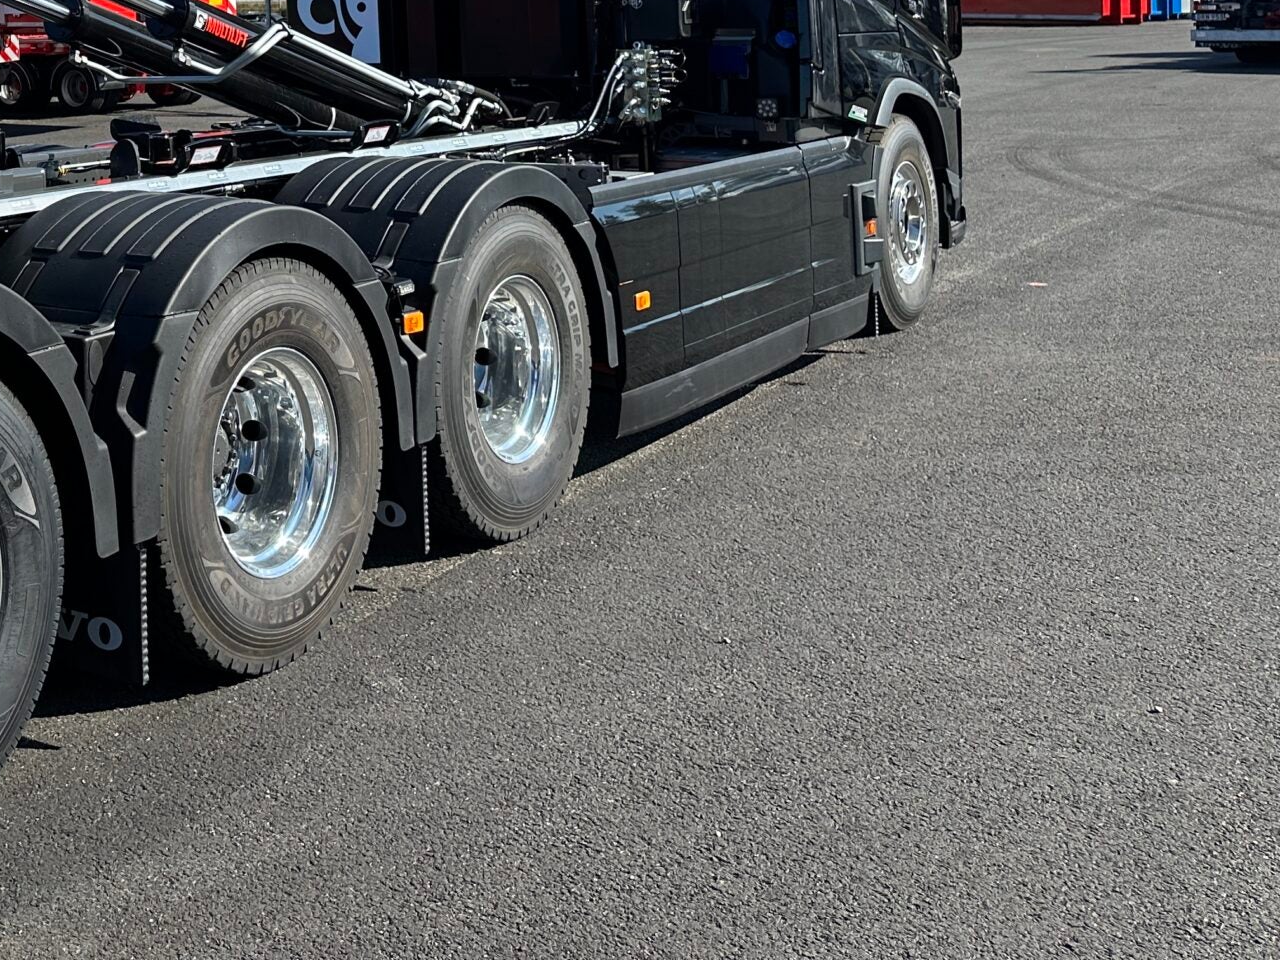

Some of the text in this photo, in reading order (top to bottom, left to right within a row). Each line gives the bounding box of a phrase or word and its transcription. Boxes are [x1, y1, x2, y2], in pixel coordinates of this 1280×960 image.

[206, 16, 249, 48] MULTILIFT
[227, 306, 341, 368] GOODYEAR
[568, 299, 582, 348] GRIP
[307, 542, 348, 606] ULTRA
